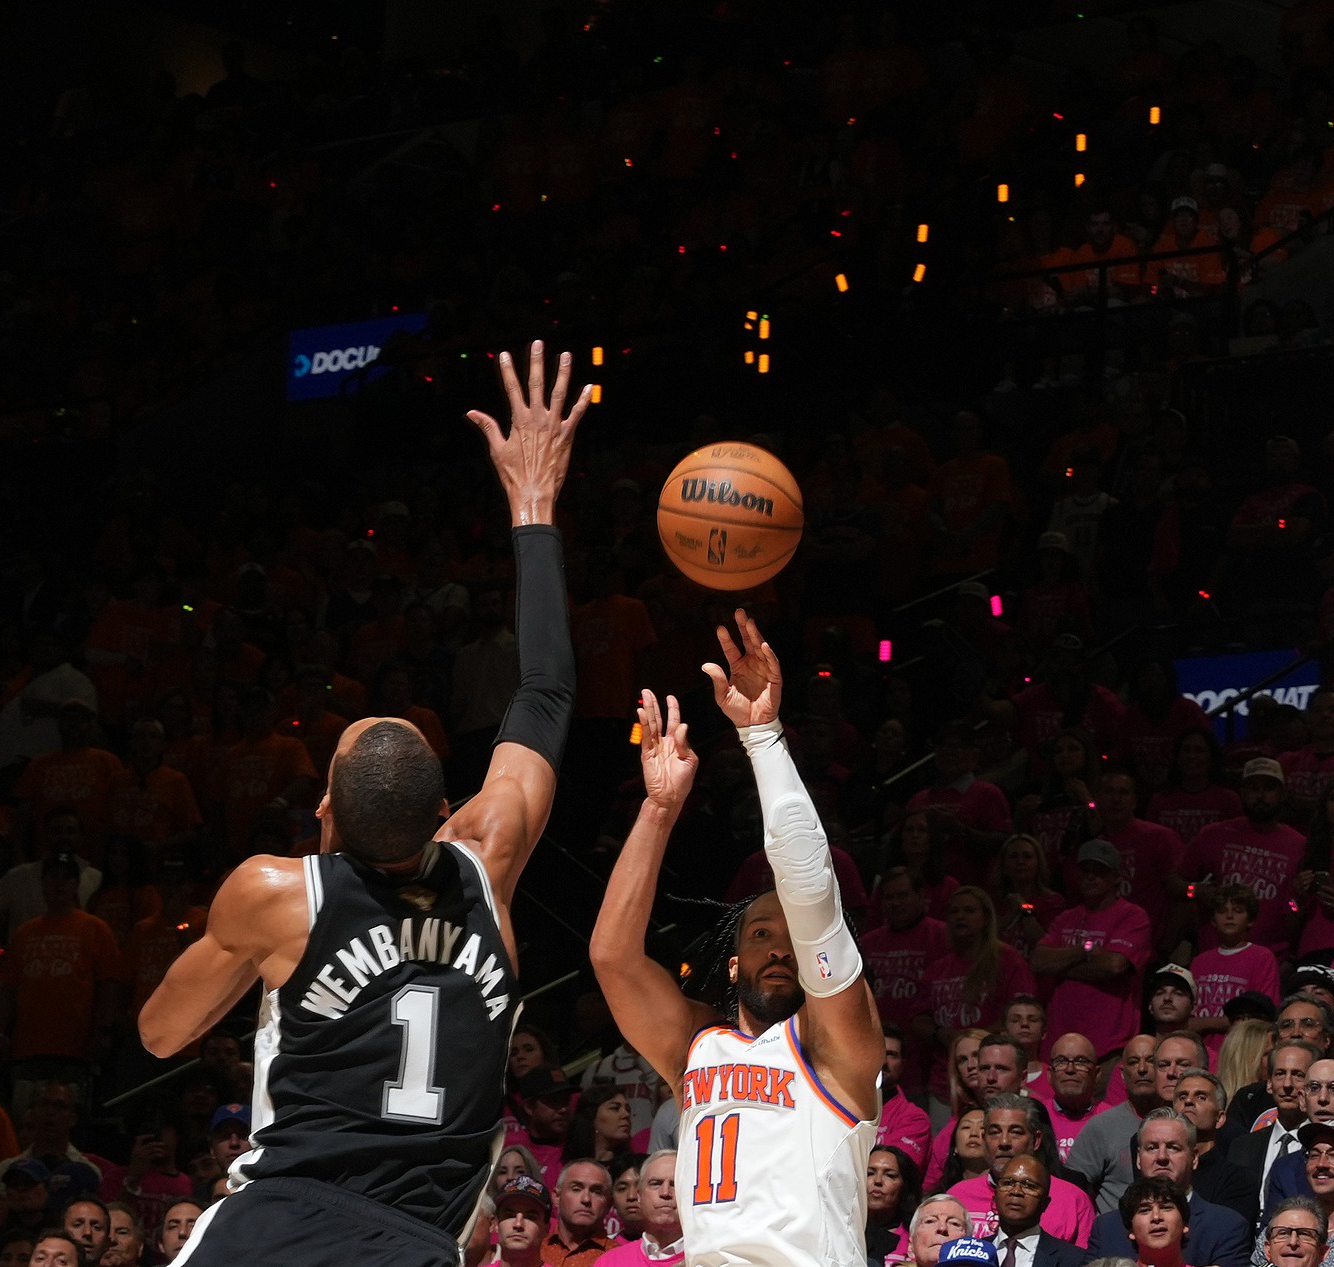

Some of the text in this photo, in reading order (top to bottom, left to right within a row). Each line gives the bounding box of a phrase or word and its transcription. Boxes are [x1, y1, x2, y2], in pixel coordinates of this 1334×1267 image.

[681, 478, 774, 518] Wilson
[300, 917, 511, 1022] WEMBANYAMA
[380, 984, 447, 1126] 1
[684, 1063, 796, 1113] EW YORK
[692, 1112, 740, 1207] 11
[1059, 1137, 1074, 1148] 20
[946, 1246, 990, 1261] Knicks
